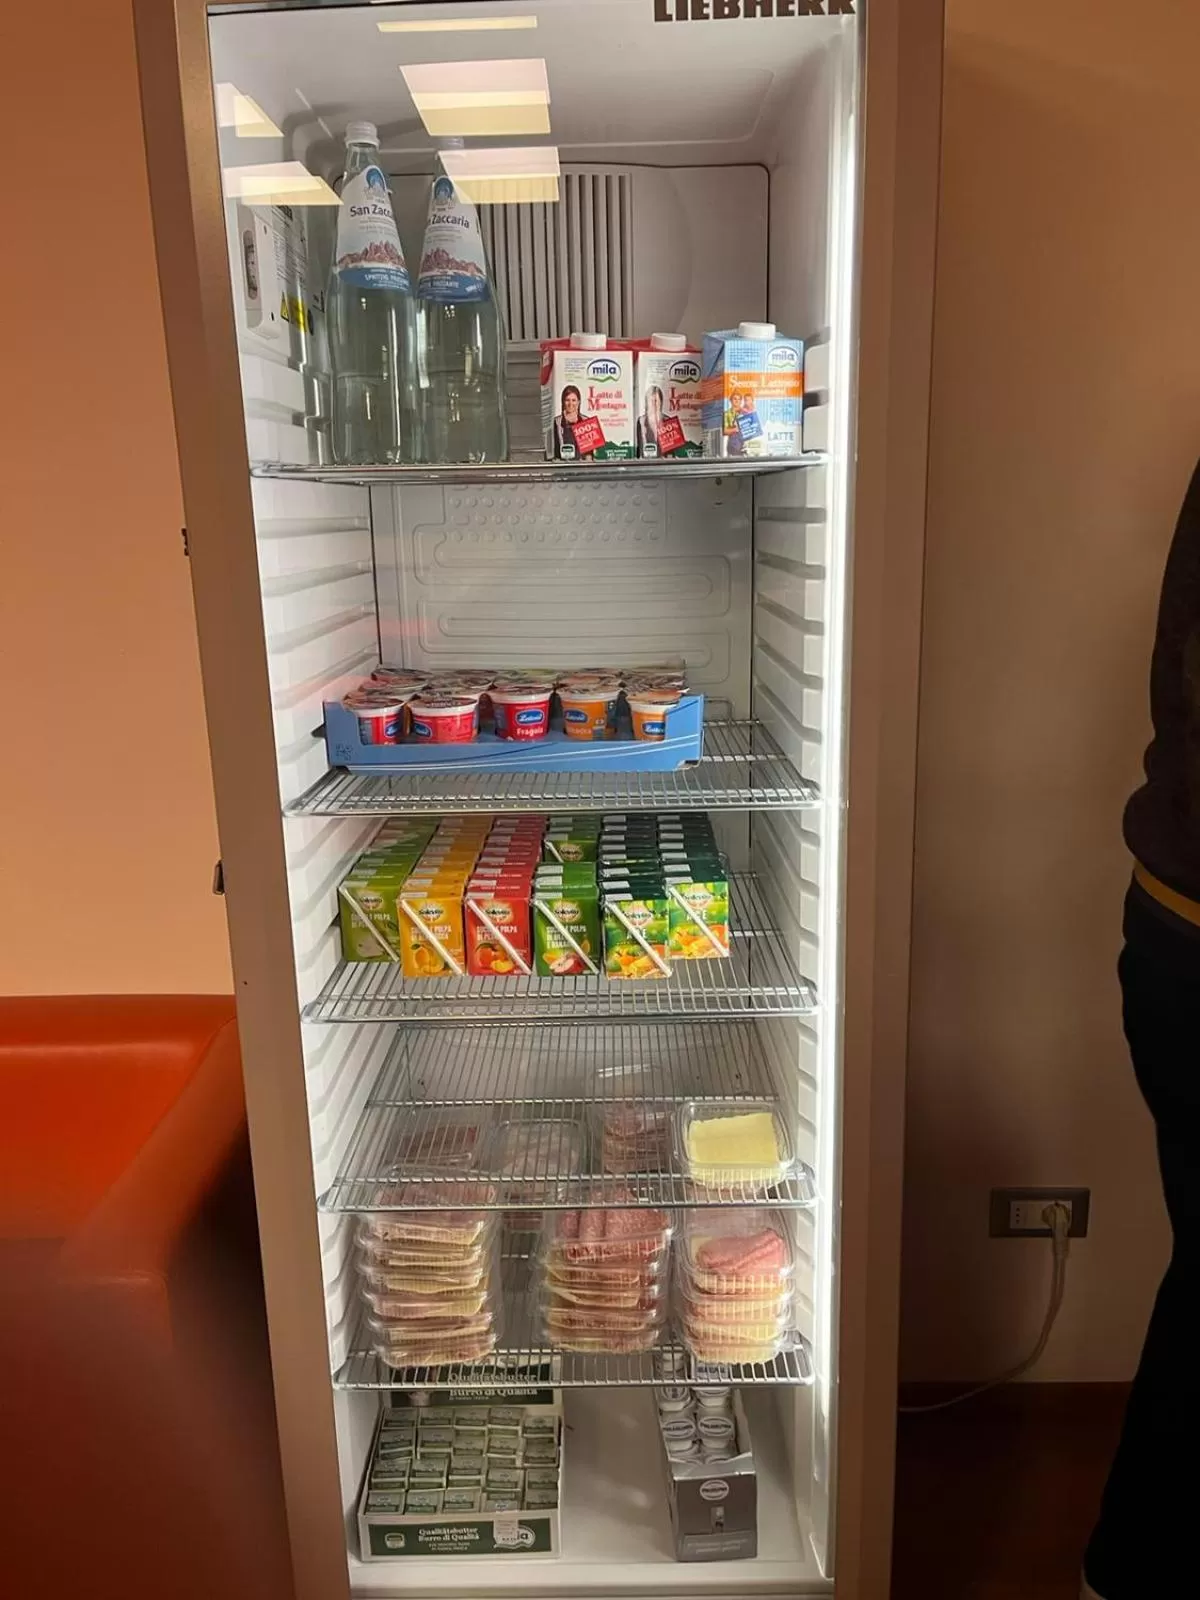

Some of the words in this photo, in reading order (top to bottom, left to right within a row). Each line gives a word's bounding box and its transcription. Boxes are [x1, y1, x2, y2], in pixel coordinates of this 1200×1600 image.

[654, 0, 856, 22] LIEBHERR
[350, 206, 370, 217] San
[432, 214, 470, 228] Zaccaria
[772, 350, 795, 361] mila
[592, 363, 617, 375] mila
[674, 365, 697, 376] mila
[588, 386, 613, 399] Latte
[588, 399, 627, 411] Montagna
[767, 431, 795, 441] LATTE
[516, 727, 544, 737] Fragola
[626, 929, 647, 940] AE
